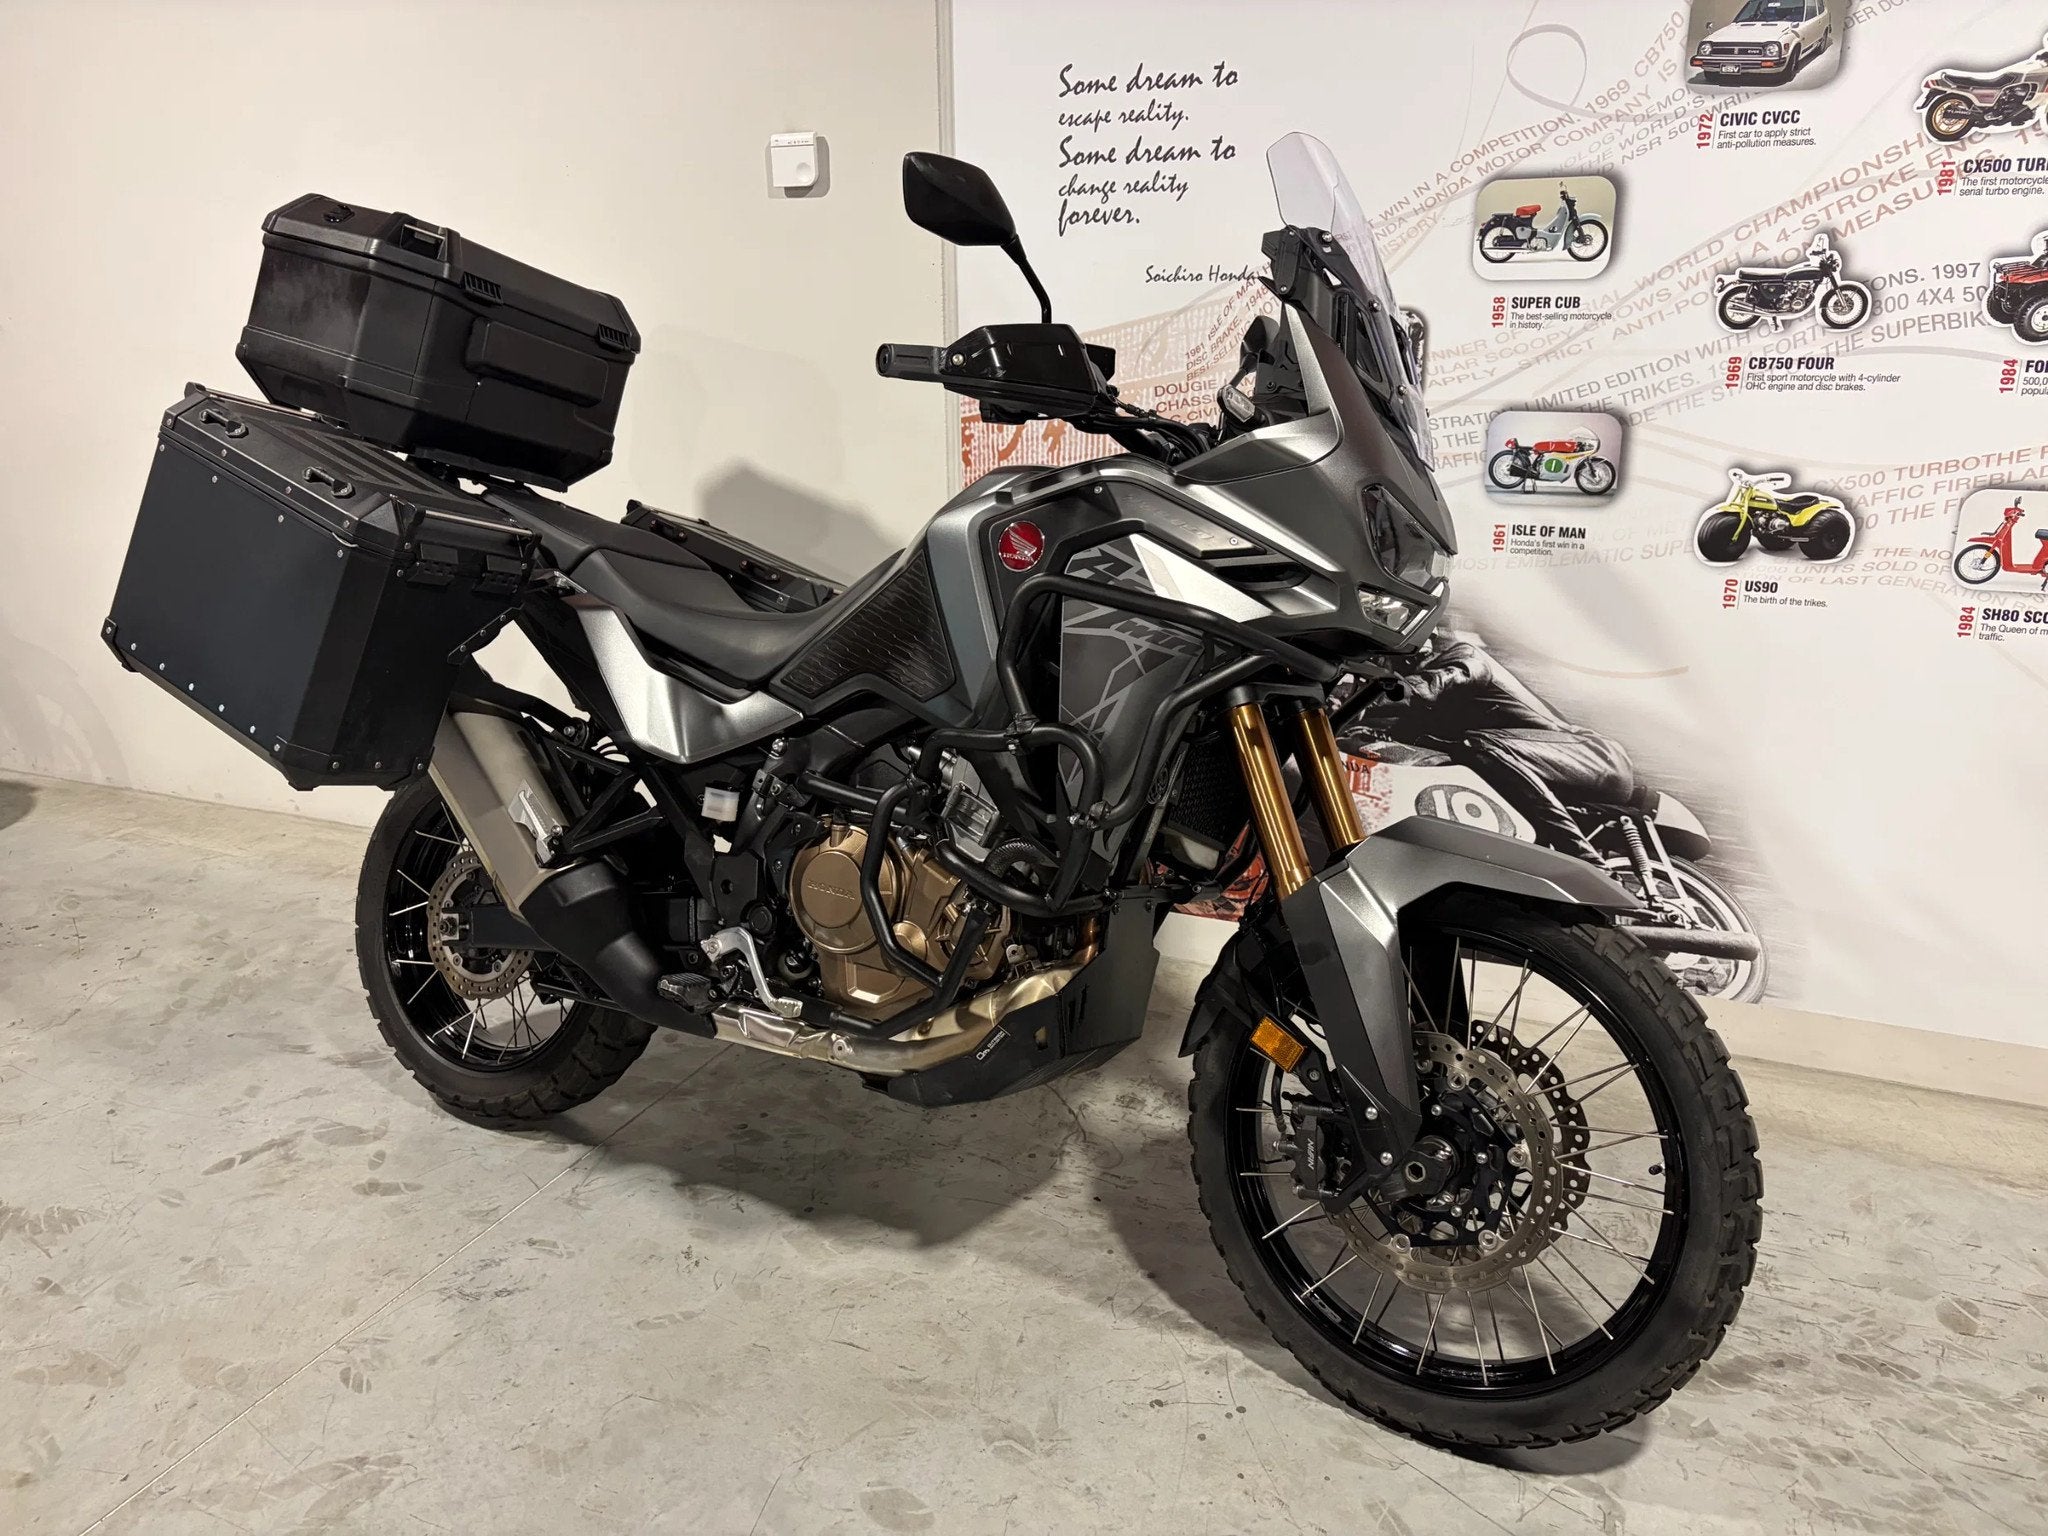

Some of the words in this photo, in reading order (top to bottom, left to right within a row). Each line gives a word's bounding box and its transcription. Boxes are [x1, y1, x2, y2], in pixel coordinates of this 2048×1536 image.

[1059, 63, 1118, 97] Some
[1126, 62, 1204, 93] dream
[1212, 60, 1239, 88] to
[1721, 66, 1740, 74] ESV
[1058, 108, 1112, 132] escape
[1118, 98, 1189, 130] reality.
[1379, 195, 1411, 222] WIN
[1412, 181, 1431, 198] IN
[1433, 171, 1449, 186] A
[1450, 112, 1580, 174] COMPETITION.
[1584, 79, 1631, 114] 1969
[1634, 11, 1684, 79] CB750
[1619, 94, 1705, 151] WORLD'S
[1720, 111, 1758, 127] CIVIC
[1762, 109, 1800, 125] CVCC
[1412, 176, 1472, 216] HONDA
[1476, 142, 1546, 177] MOTOR
[1553, 84, 1652, 147] COMPANY
[1659, 60, 1678, 82] IS
[1621, 136, 1662, 164] NSR
[1667, 114, 1702, 140] 500
[1696, 112, 1713, 151] 1972
[1718, 130, 1738, 140] First
[1739, 130, 1753, 139] car
[1754, 129, 1763, 139] to
[1764, 128, 1789, 141] apply
[1790, 126, 1811, 137] strict
[1059, 135, 1117, 168] Some
[1125, 135, 1201, 164] dream
[1211, 135, 1236, 161] to
[1717, 138, 1769, 150] anti-pollution
[1770, 137, 1816, 147] measures.
[1963, 158, 2012, 174] CX500
[1058, 174, 1117, 204] change
[1123, 170, 1189, 202] reality
[1937, 160, 1956, 196] 1981
[1962, 177, 1979, 186] The
[1980, 176, 1999, 187] first
[1959, 186, 1984, 196] serial
[1986, 185, 2011, 196] turbo
[2011, 185, 2045, 199] engine.
[1058, 198, 1141, 237] forever.
[1635, 239, 1725, 292] WORLD
[1734, 131, 1934, 243] CHAMPIONSHI
[1485, 326, 1576, 363] SCOOPY
[1677, 252, 1743, 292] WITH
[1751, 240, 1770, 259] A
[1776, 162, 1918, 244] 4-STROKE
[1932, 262, 1981, 280] 1997
[1145, 265, 1203, 283] Soichiro
[1208, 265, 1258, 282] Honda
[1511, 296, 1552, 309] SUPER
[1555, 296, 1581, 309] CUB
[1916, 286, 1955, 306] 4X4
[1207, 318, 1223, 341] ISLE
[1223, 298, 1235, 318] OF
[1492, 296, 1506, 328] 1958
[1511, 311, 1525, 320] The
[1526, 311, 1568, 322] best-selling
[1569, 311, 1613, 322] motorcycle
[1509, 320, 1518, 330] in
[1518, 320, 1546, 330] history.
[1821, 330, 1864, 360] THE
[1871, 310, 1990, 344] SUPERBIK
[1186, 351, 1208, 371] DISC
[1428, 367, 1497, 389] APPLY
[1518, 336, 1596, 370] STRICT
[1604, 350, 1692, 390] EDITION
[1695, 330, 1751, 361] WITH
[1748, 356, 1794, 371] CB750
[1797, 356, 1835, 371] FOUR
[1724, 356, 1743, 391] 1969
[1747, 372, 1765, 383] First
[1766, 373, 1788, 385] sport
[1789, 373, 1837, 384] motorcycle
[1838, 373, 1857, 382] with
[1858, 373, 1901, 385] 4-cylinder
[1999, 359, 2019, 394] 1984
[1154, 380, 1218, 398] DOUGIE
[1618, 371, 1701, 408] TRIKES.
[1745, 382, 1767, 392] OHC
[1768, 384, 1797, 395] engine
[1797, 382, 1814, 392] and
[1815, 382, 1834, 392] disc
[1835, 382, 1866, 392] brakes.
[1663, 391, 1705, 416] THE
[1443, 431, 1481, 448] THE
[1888, 502, 1936, 525] THE
[1492, 523, 1506, 552] 1961
[1512, 524, 1537, 536] ISLE
[1539, 525, 1556, 537] OF
[1558, 526, 1586, 539] MAN
[1509, 547, 1554, 558] competition.
[1510, 538, 1540, 548] Honda's
[1540, 539, 1555, 548] first
[1556, 541, 1569, 549] win
[1569, 541, 1577, 549] in
[1873, 547, 1914, 558] THE
[1861, 559, 1918, 574] SOLD
[1744, 580, 1779, 595] US90
[1819, 575, 1874, 586] LAST
[1722, 578, 1738, 610] 1970
[1743, 595, 1758, 605] The
[1758, 596, 1778, 606] birth
[1778, 598, 1789, 607] of
[1788, 598, 1803, 608] the
[1803, 600, 1829, 610] trikes.
[1956, 606, 1976, 638] 1984
[1981, 608, 2019, 623] SH80
[1978, 633, 2005, 644] traffic.
[1980, 623, 1997, 634] The
[1998, 624, 2028, 637] Queen
[2028, 627, 2040, 637] of
[1341, 760, 1370, 774] NDA
[807, 878, 856, 901] HONDA
